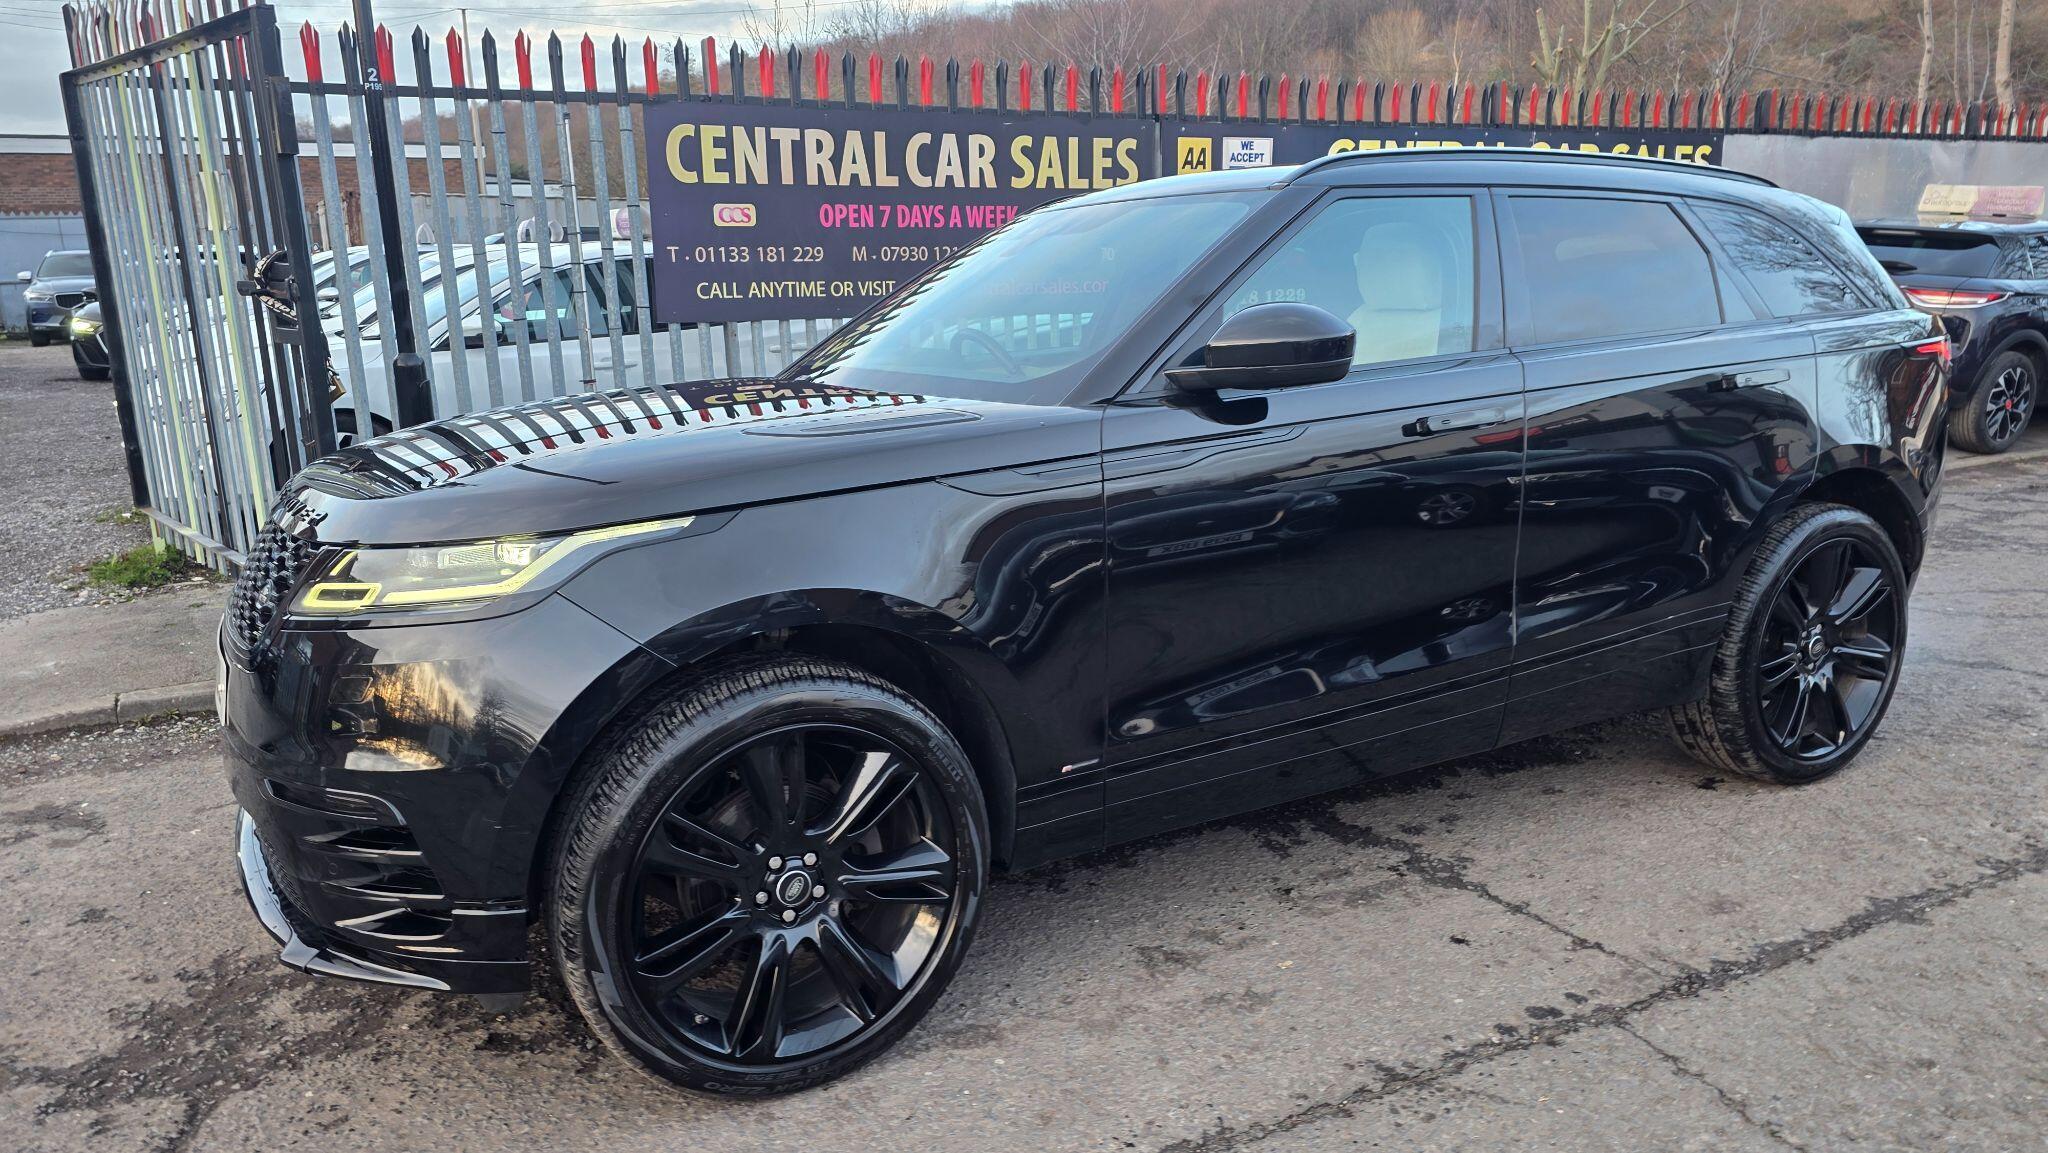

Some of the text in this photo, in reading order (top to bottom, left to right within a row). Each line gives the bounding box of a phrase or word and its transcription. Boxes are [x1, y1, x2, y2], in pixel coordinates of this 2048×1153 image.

[367, 67, 378, 81] 2
[1240, 140, 1255, 151] WE
[666, 123, 1139, 190] CENTRAL CAR SALES
[1182, 147, 1207, 170] AA
[1230, 152, 1265, 163] ACCEPT
[718, 206, 752, 224] CCS
[819, 203, 1018, 228] OPEN 7 DAYS A WEEK
[695, 246, 749, 263] 01133
[757, 246, 785, 263] 181
[792, 246, 824, 262] 229
[880, 246, 928, 262] 07930
[934, 246, 958, 261] 12
[696, 282, 743, 299] CALL
[748, 281, 827, 298] ANYTIME
[830, 281, 854, 297] OR
[858, 280, 896, 296] VISIT
